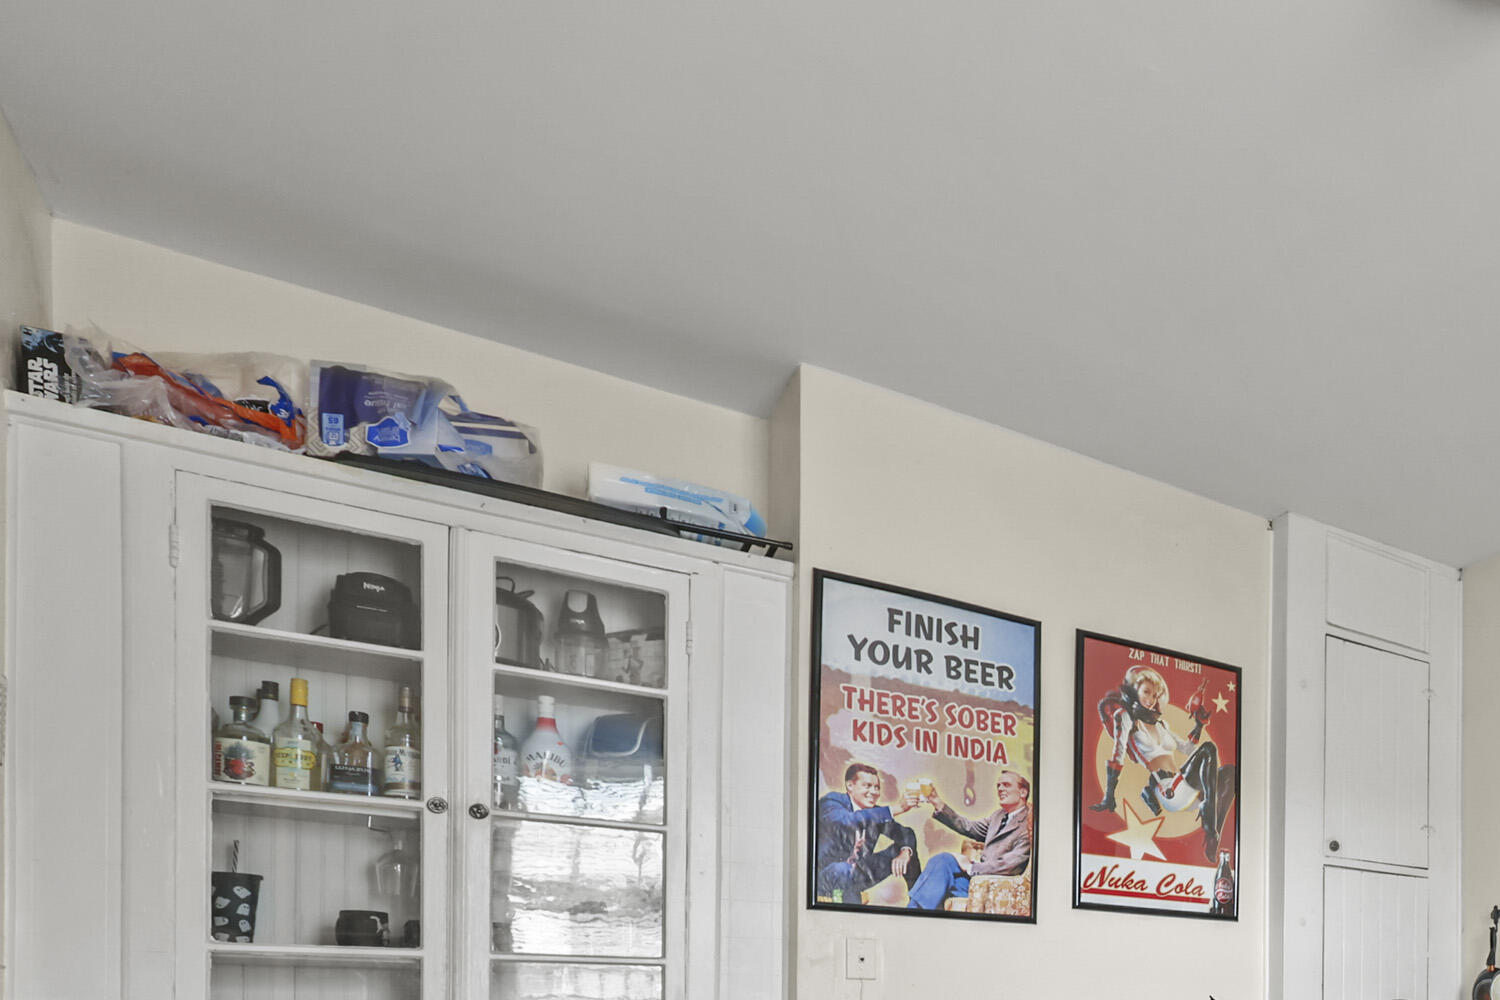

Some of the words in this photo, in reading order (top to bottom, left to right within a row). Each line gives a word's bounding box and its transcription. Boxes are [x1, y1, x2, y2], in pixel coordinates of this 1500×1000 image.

[887, 608, 980, 650] FINISH
[847, 634, 934, 675] YOUR
[944, 655, 1015, 691] BEER
[1128, 648, 1145, 661] ZAP
[1150, 652, 1170, 667] THAT
[842, 685, 938, 723] THERE'S
[945, 704, 1017, 736] SOBER
[852, 719, 907, 748] KIDS
[915, 728, 938, 753] IN
[947, 734, 1008, 764] INDIA
[1083, 864, 1148, 891] Nuka
[1155, 873, 1205, 897] Cola
